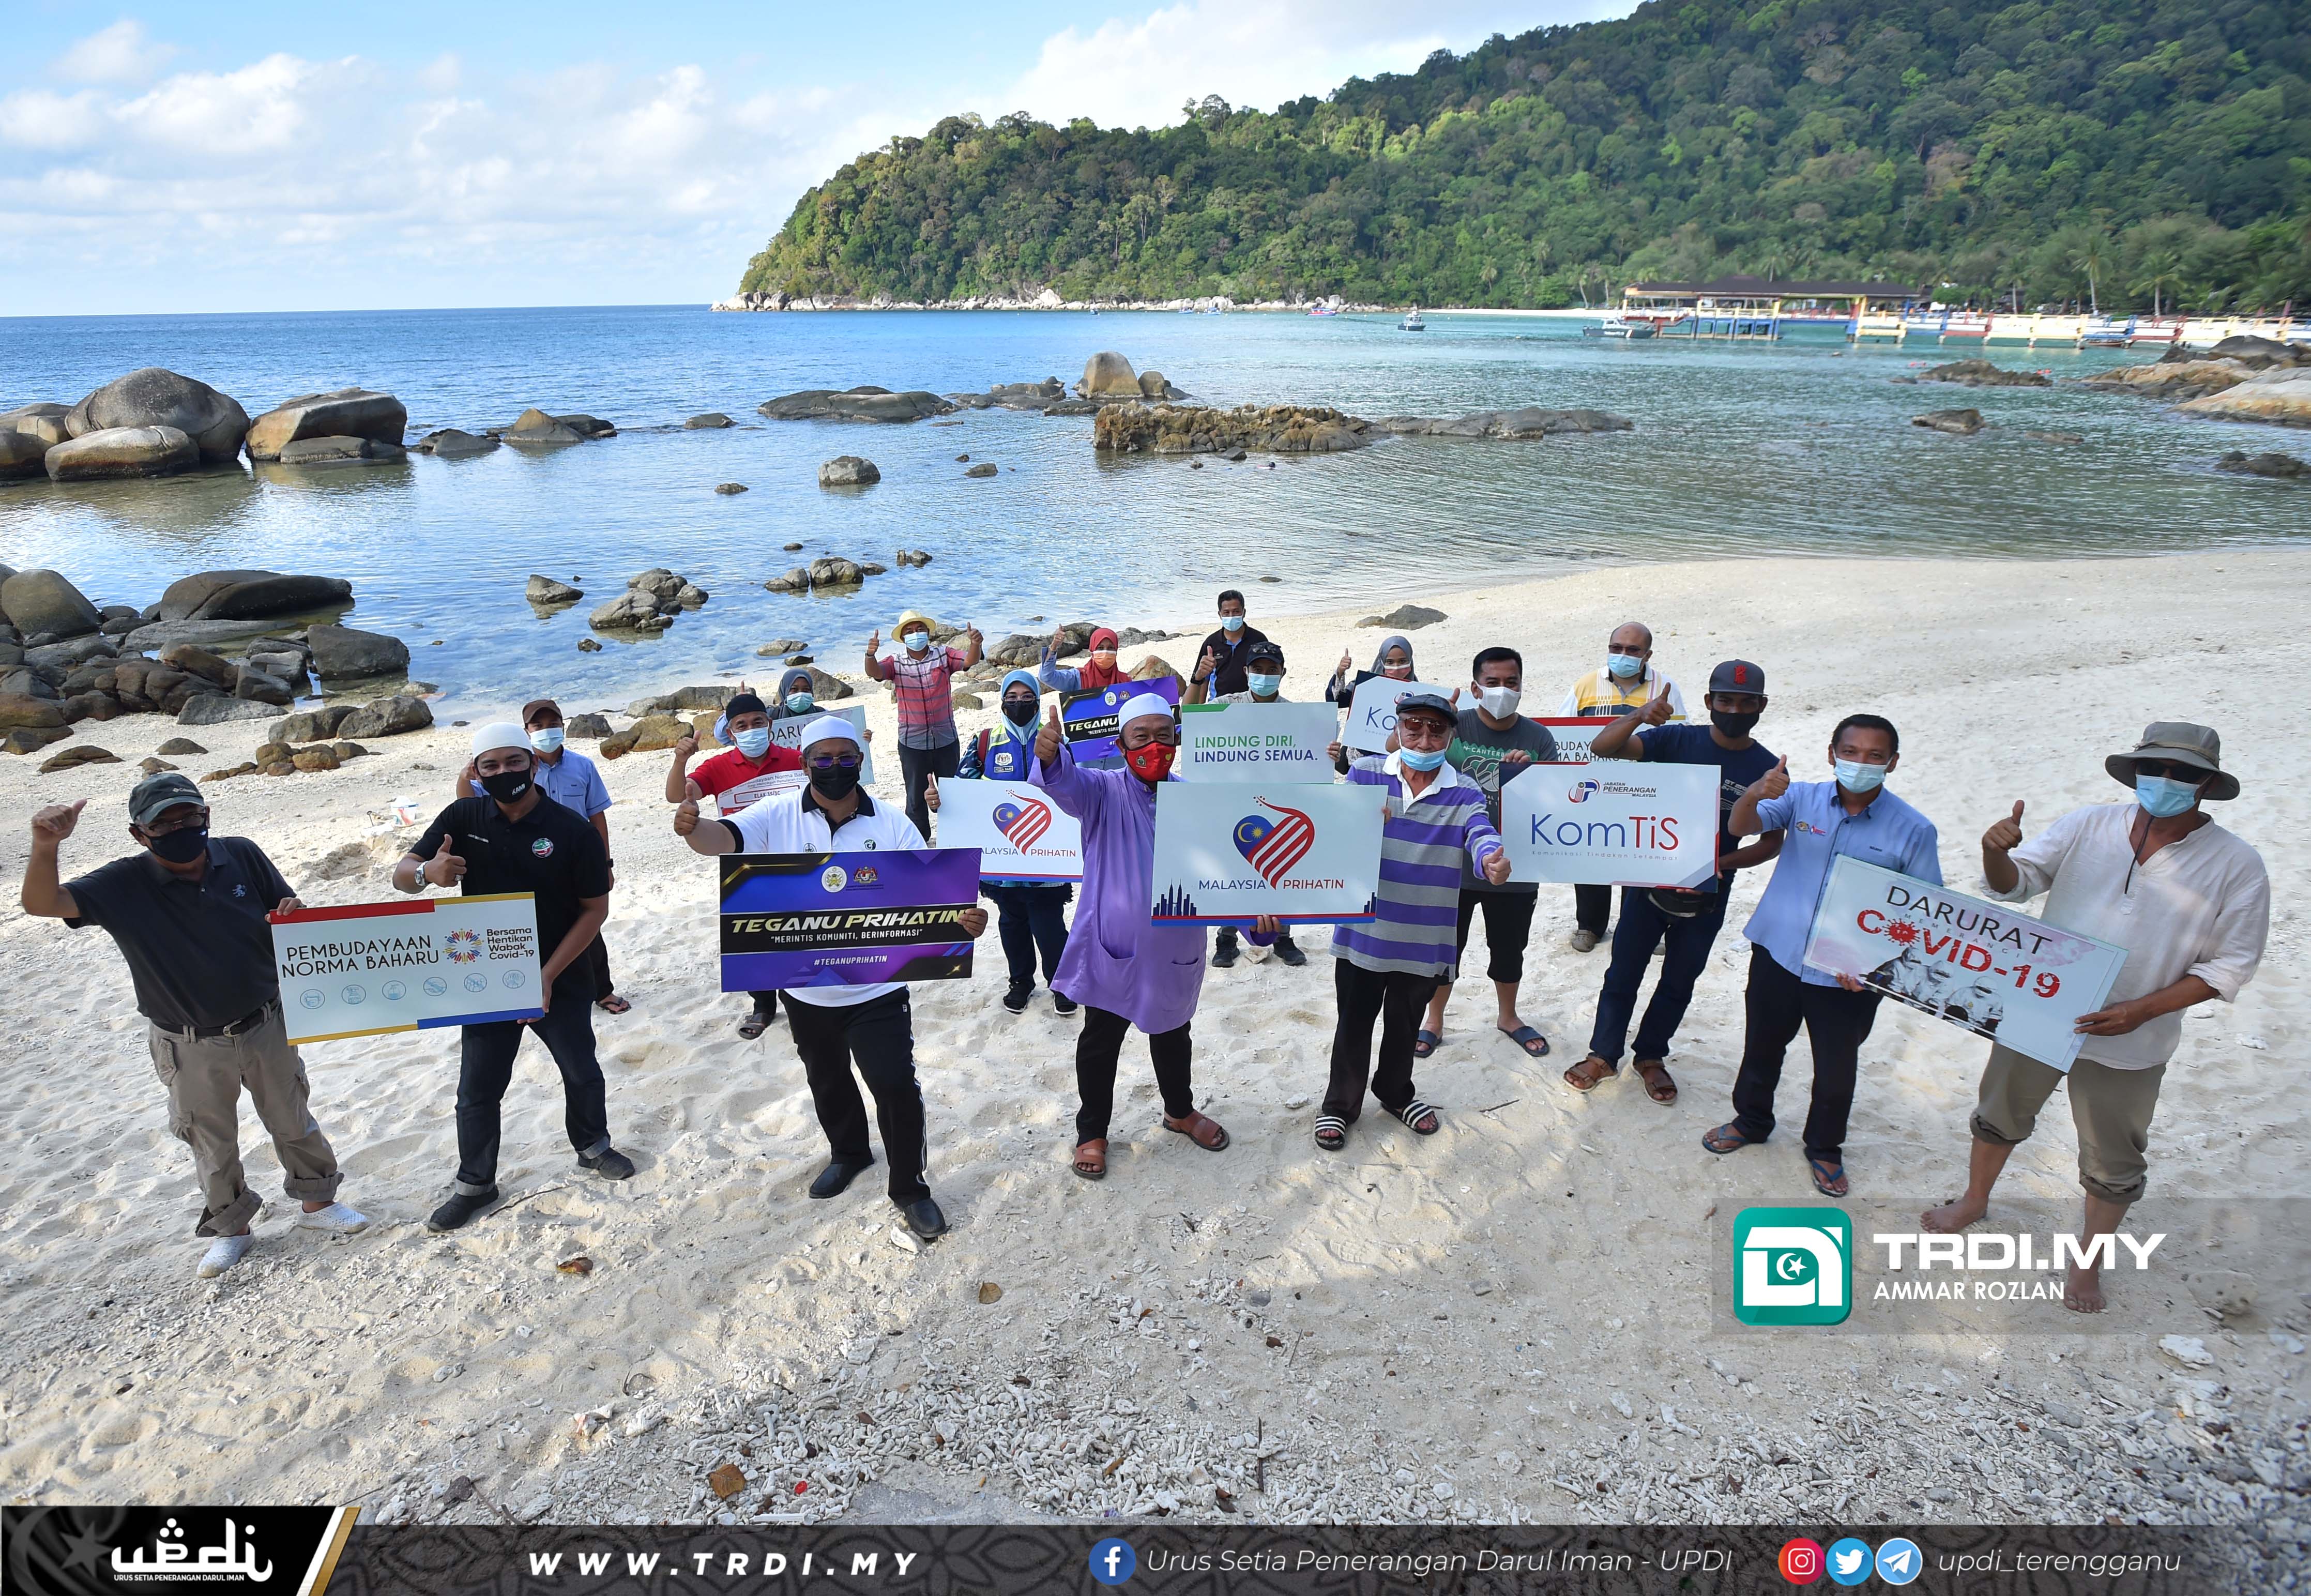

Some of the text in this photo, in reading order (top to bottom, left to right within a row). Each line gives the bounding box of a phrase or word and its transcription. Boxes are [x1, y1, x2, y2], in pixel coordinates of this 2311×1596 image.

[1069, 717, 1118, 732] TEGANU
[1195, 735, 1296, 748] LINDUNG DIRI,
[1194, 749, 1318, 763] LINDUNG SEMUA.
[1531, 813, 1679, 850] KomTiS
[1030, 848, 1076, 857] PRIHATIN
[1199, 879, 1344, 890] MALAYSIA PRIHATIN
[731, 916, 842, 933] TEGANU
[1886, 885, 2052, 955] DARURAT
[486, 927, 532, 937] Bersama
[816, 932, 858, 942] KOMUNITI,
[488, 935, 533, 945] Hentikan
[286, 935, 431, 962] PEMBUDAYAAN
[489, 943, 526, 952] Wabak
[489, 950, 535, 960] Covid-19
[814, 955, 888, 966] #TEGANUPRIHATIN
[282, 950, 439, 978] NORMA BAHARU
